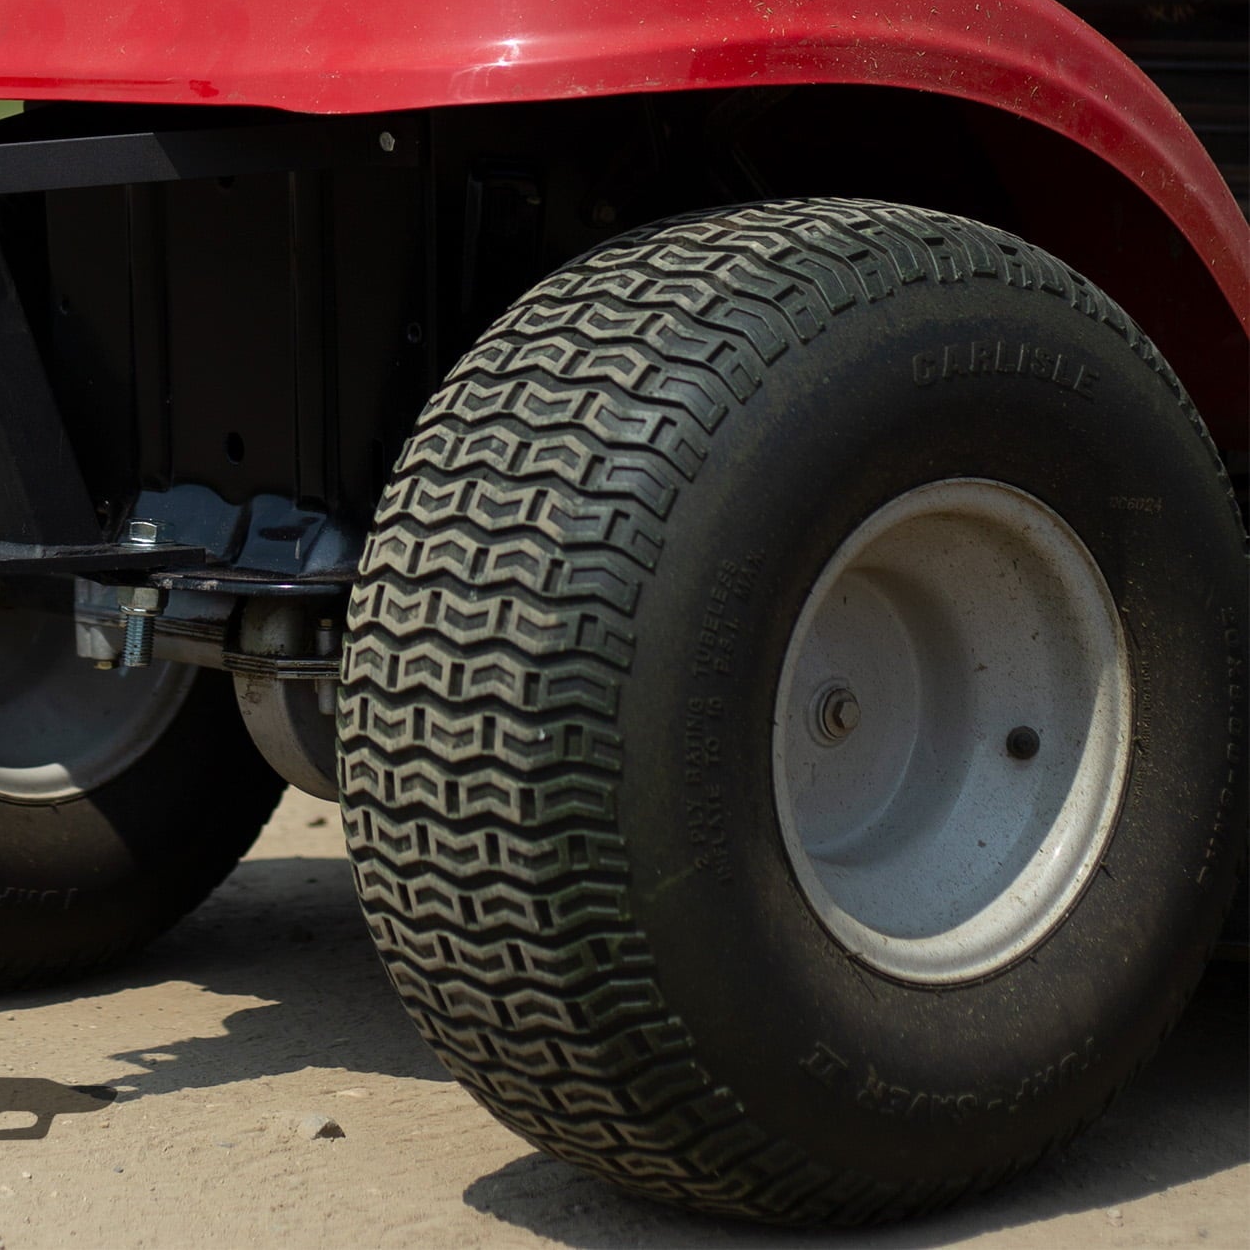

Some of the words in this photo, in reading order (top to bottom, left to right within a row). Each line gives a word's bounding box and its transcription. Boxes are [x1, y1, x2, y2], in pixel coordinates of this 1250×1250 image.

[912, 340, 1100, 403] CARLISLE
[691, 557, 739, 679] TUBELESS
[684, 696, 705, 783] RATING
[704, 735, 722, 765] TO
[684, 797, 706, 845] PLY
[705, 782, 735, 886] INFLATE
